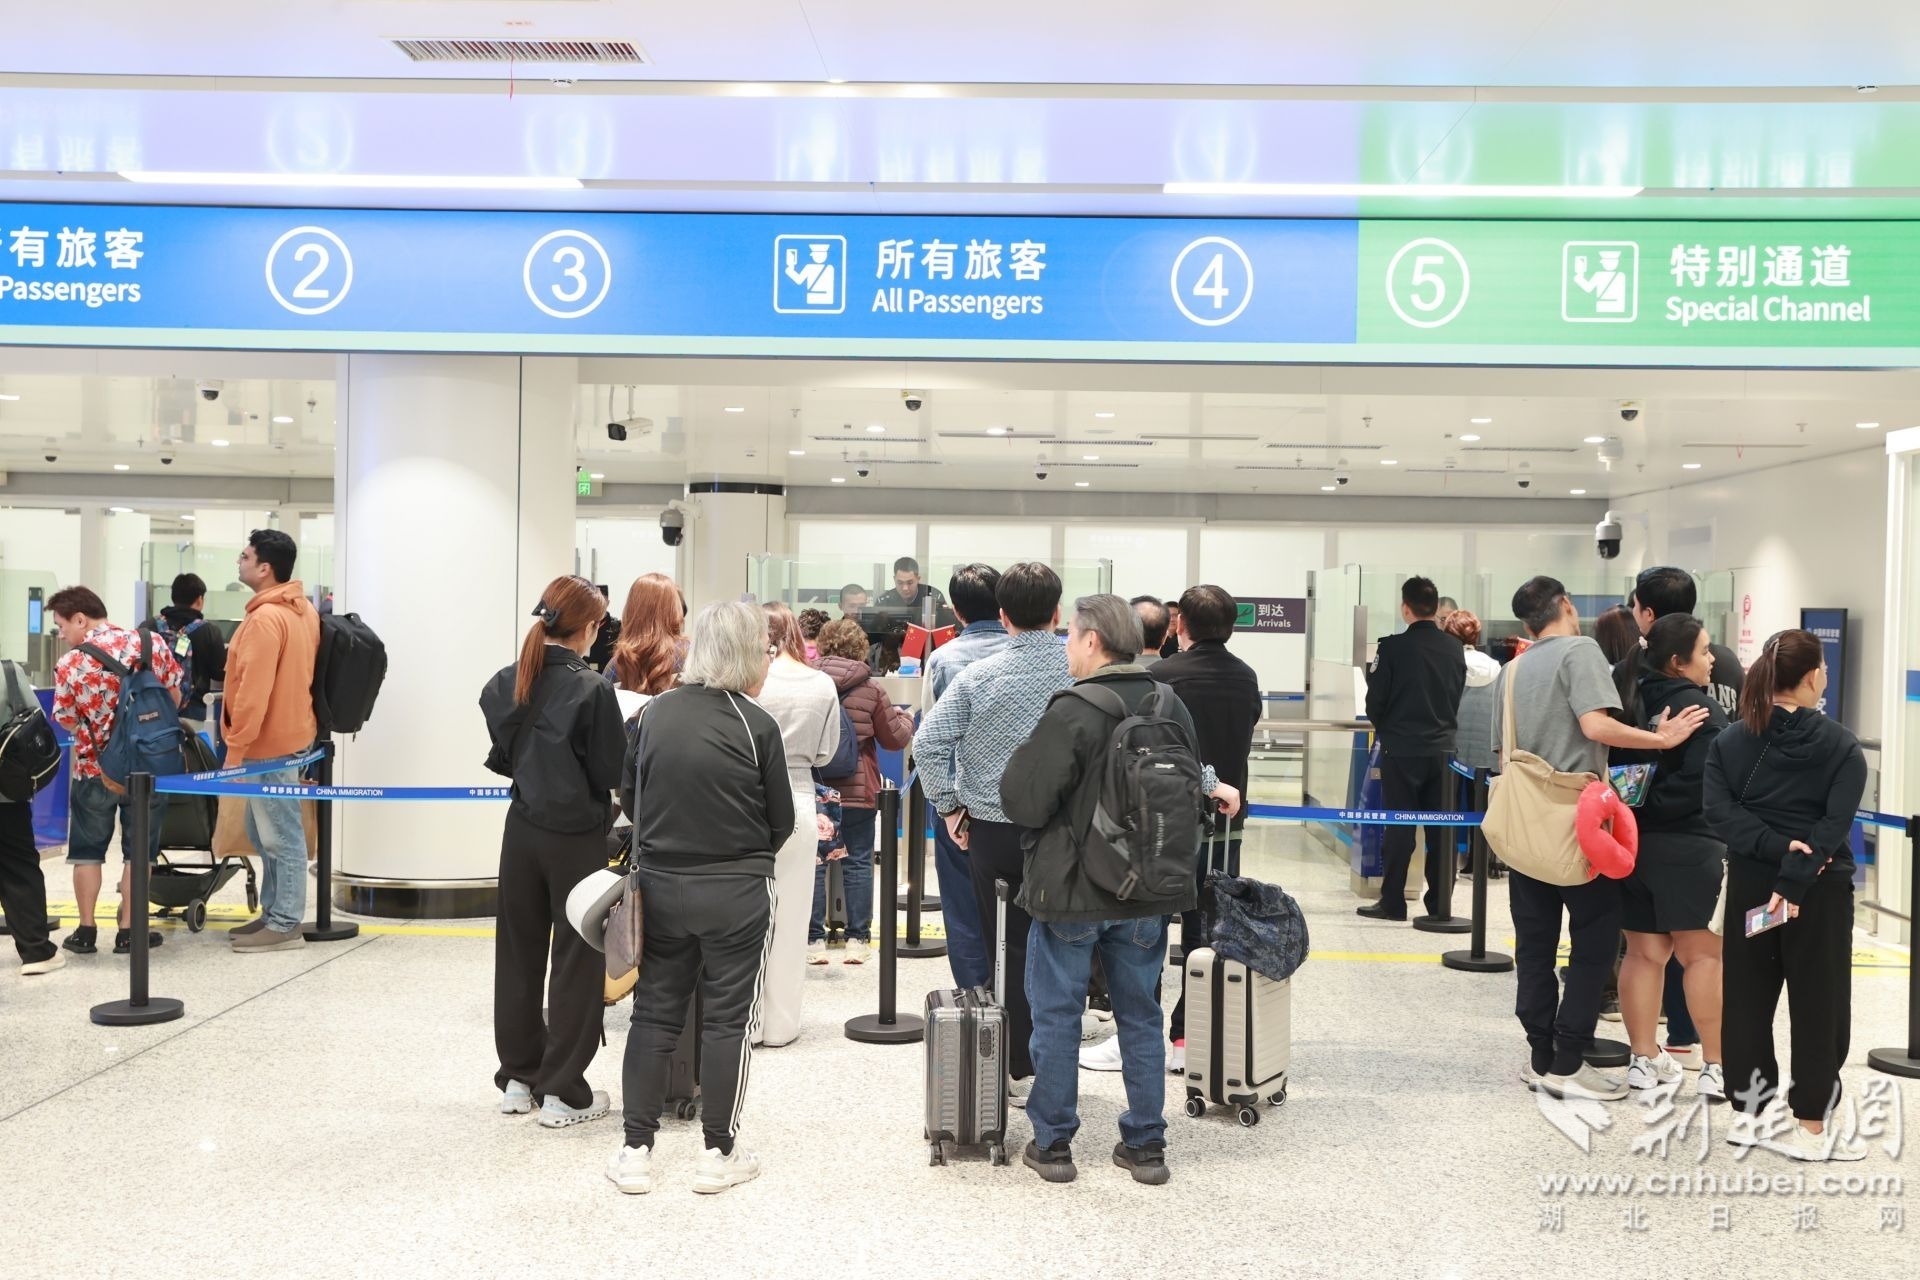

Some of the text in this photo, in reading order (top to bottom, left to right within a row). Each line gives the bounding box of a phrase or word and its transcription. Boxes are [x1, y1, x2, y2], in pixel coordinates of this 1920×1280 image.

[0, 226, 143, 270] 有旅客
[876, 238, 1046, 281] 所有旅客
[1670, 244, 1851, 287] 特别通道
[0, 275, 141, 308] Passengers
[872, 288, 1043, 320] All Passengers
[1666, 295, 1871, 326] Special Channel
[1257, 619, 1291, 628] Arrivals
[1258, 604, 1284, 617] 到达
[315, 788, 338, 796] CHINA
[338, 788, 383, 797] IMMIGRATION
[1394, 813, 1417, 821] CHINA
